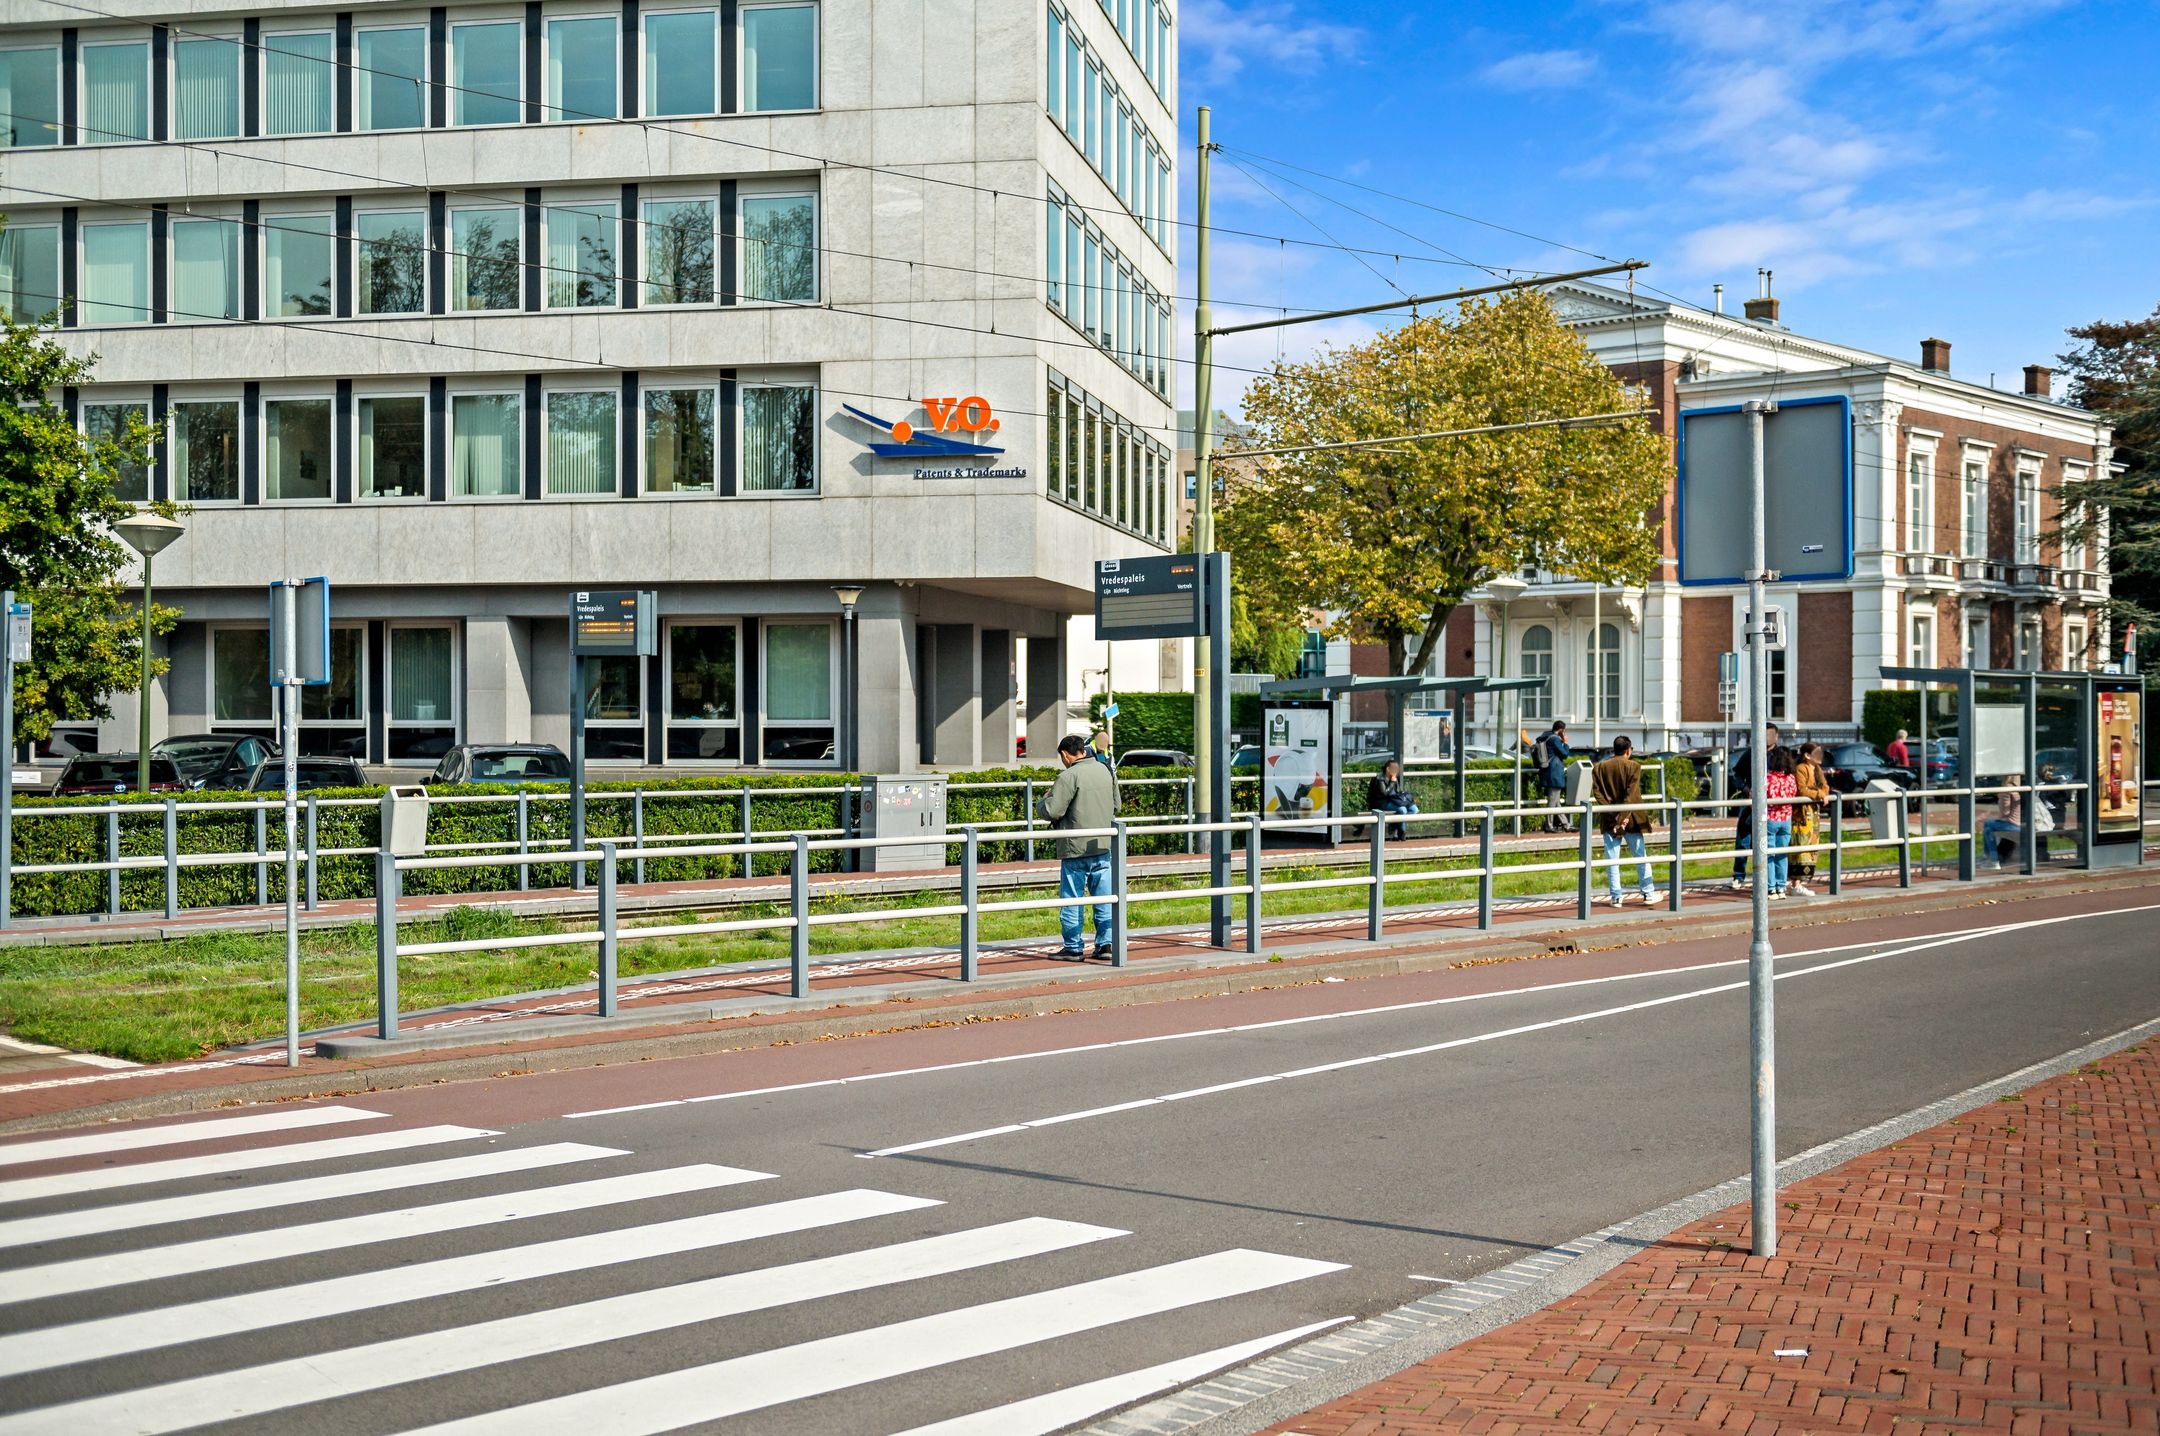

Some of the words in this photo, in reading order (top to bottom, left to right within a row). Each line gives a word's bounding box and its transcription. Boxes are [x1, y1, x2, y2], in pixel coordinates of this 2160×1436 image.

[915, 469, 952, 479] Patents
[954, 468, 964, 477] &
[966, 467, 1027, 478] Trademarks
[1101, 573, 1145, 585] Vredespaleis
[577, 605, 604, 613] Vredespaleis
